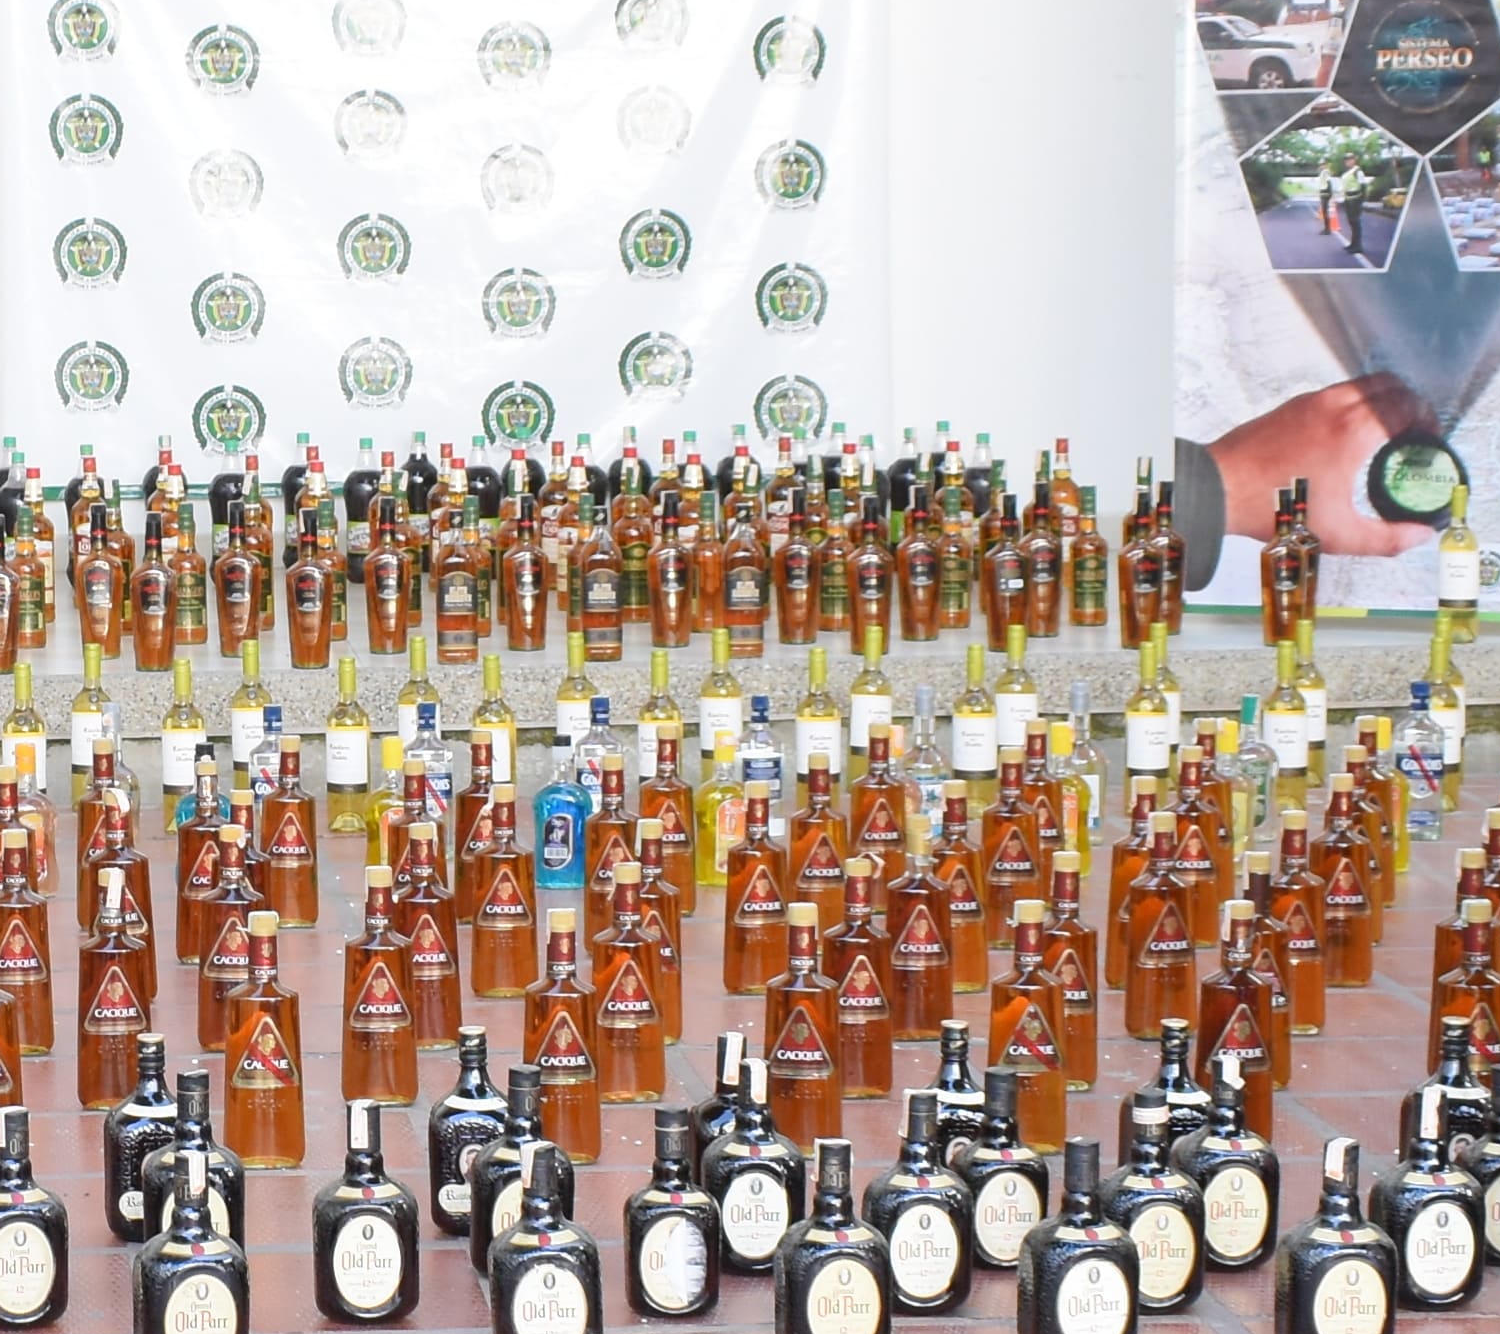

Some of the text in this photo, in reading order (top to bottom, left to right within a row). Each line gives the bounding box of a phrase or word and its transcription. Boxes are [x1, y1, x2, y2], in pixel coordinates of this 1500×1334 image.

[1375, 46, 1474, 71] PERSEO
[1384, 472, 1458, 485] COLOMBIA
[273, 844, 307, 855] CACIQUE
[486, 903, 526, 915] CACIQUE
[744, 901, 782, 912] CACIQUE
[94, 1007, 138, 1018] CACIQUE
[360, 1002, 405, 1015] CACIQUE
[606, 1001, 651, 1013] CACIQUE
[540, 1055, 585, 1067] CACIQUE
[778, 1049, 822, 1061] CACIQUE
